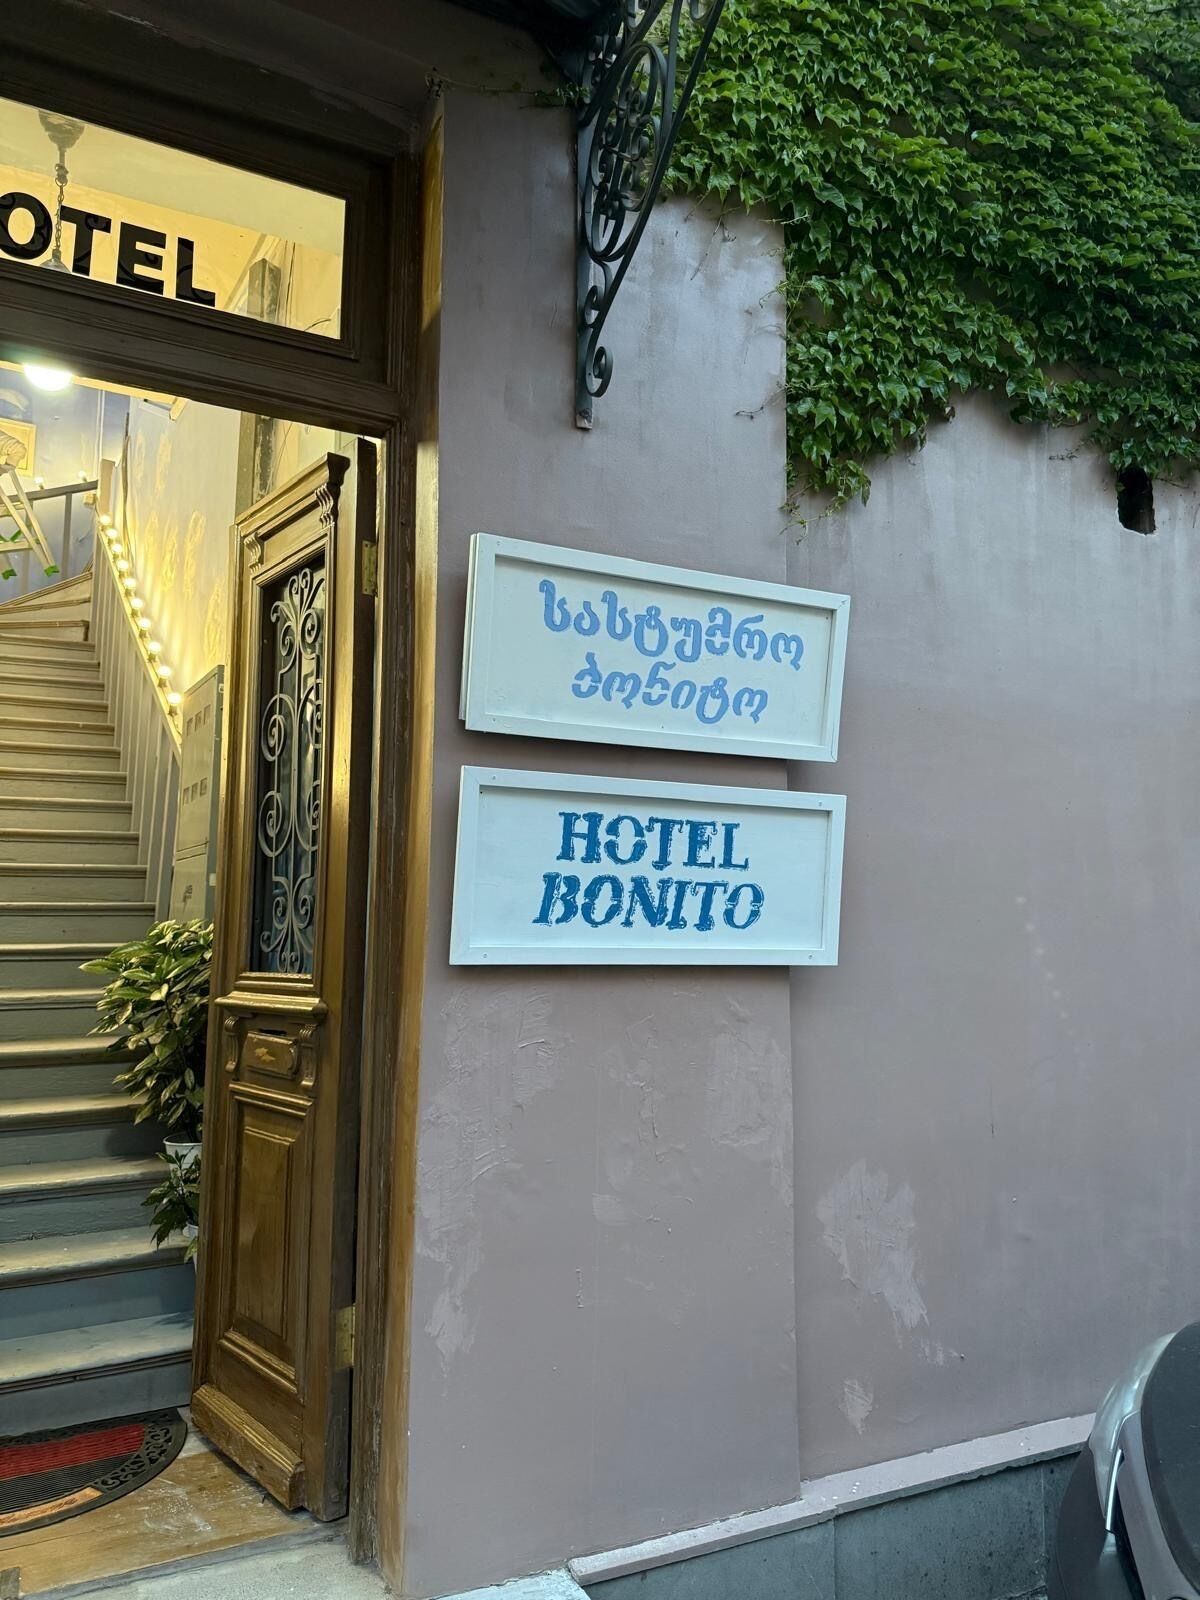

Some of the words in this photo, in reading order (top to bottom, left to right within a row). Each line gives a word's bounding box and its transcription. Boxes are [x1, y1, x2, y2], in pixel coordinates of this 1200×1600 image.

[539, 579, 804, 671] სასტუმრო
[572, 652, 768, 724] ბონიტო
[555, 811, 749, 870] HOTEL
[531, 871, 765, 931] BONITO
